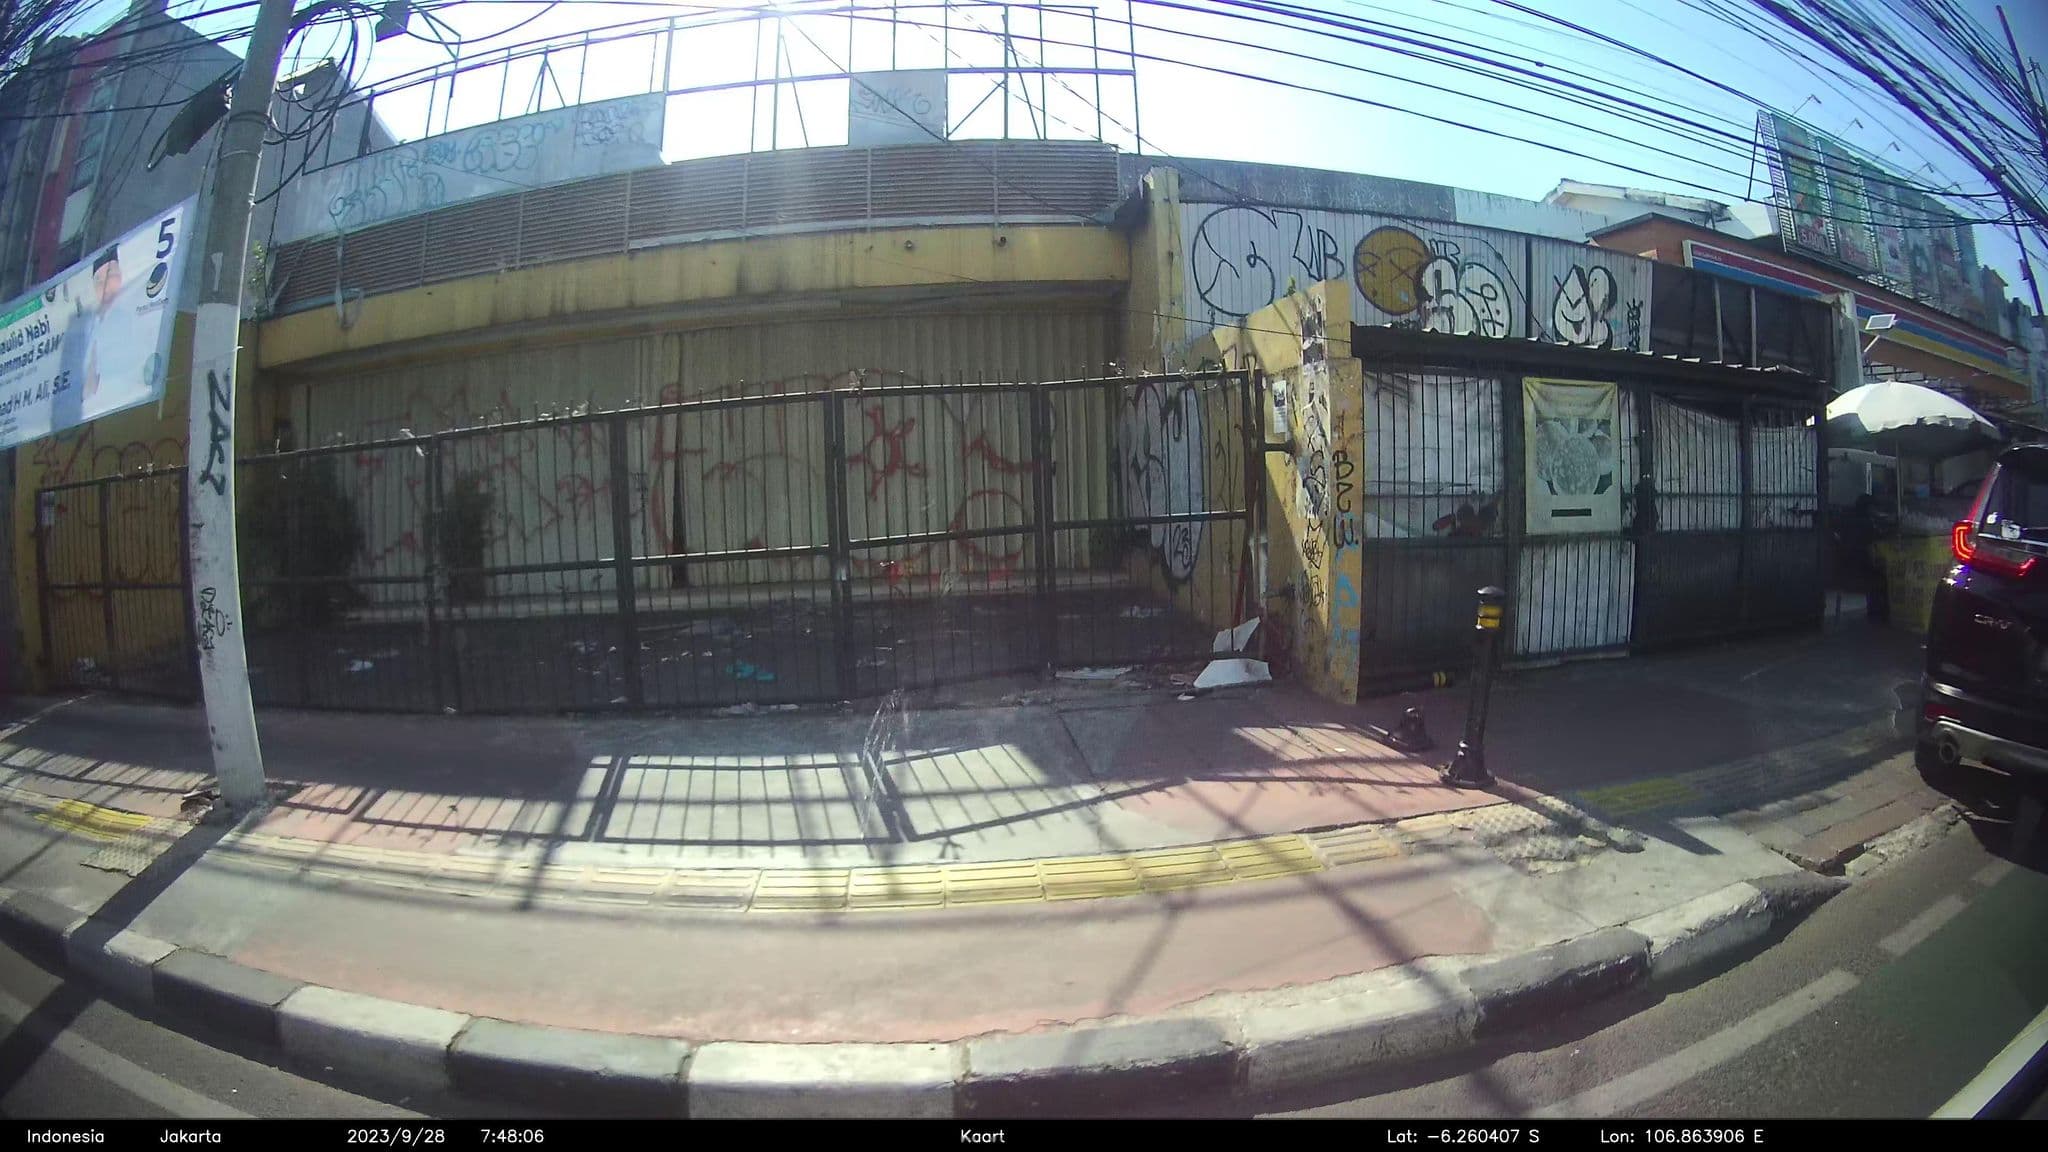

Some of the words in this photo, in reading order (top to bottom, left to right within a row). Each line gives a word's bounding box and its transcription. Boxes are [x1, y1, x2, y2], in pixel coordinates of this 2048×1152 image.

[156, 217, 176, 259] 5
[24, 313, 51, 343] Nabi
[1974, 613, 2012, 630] CR-V
